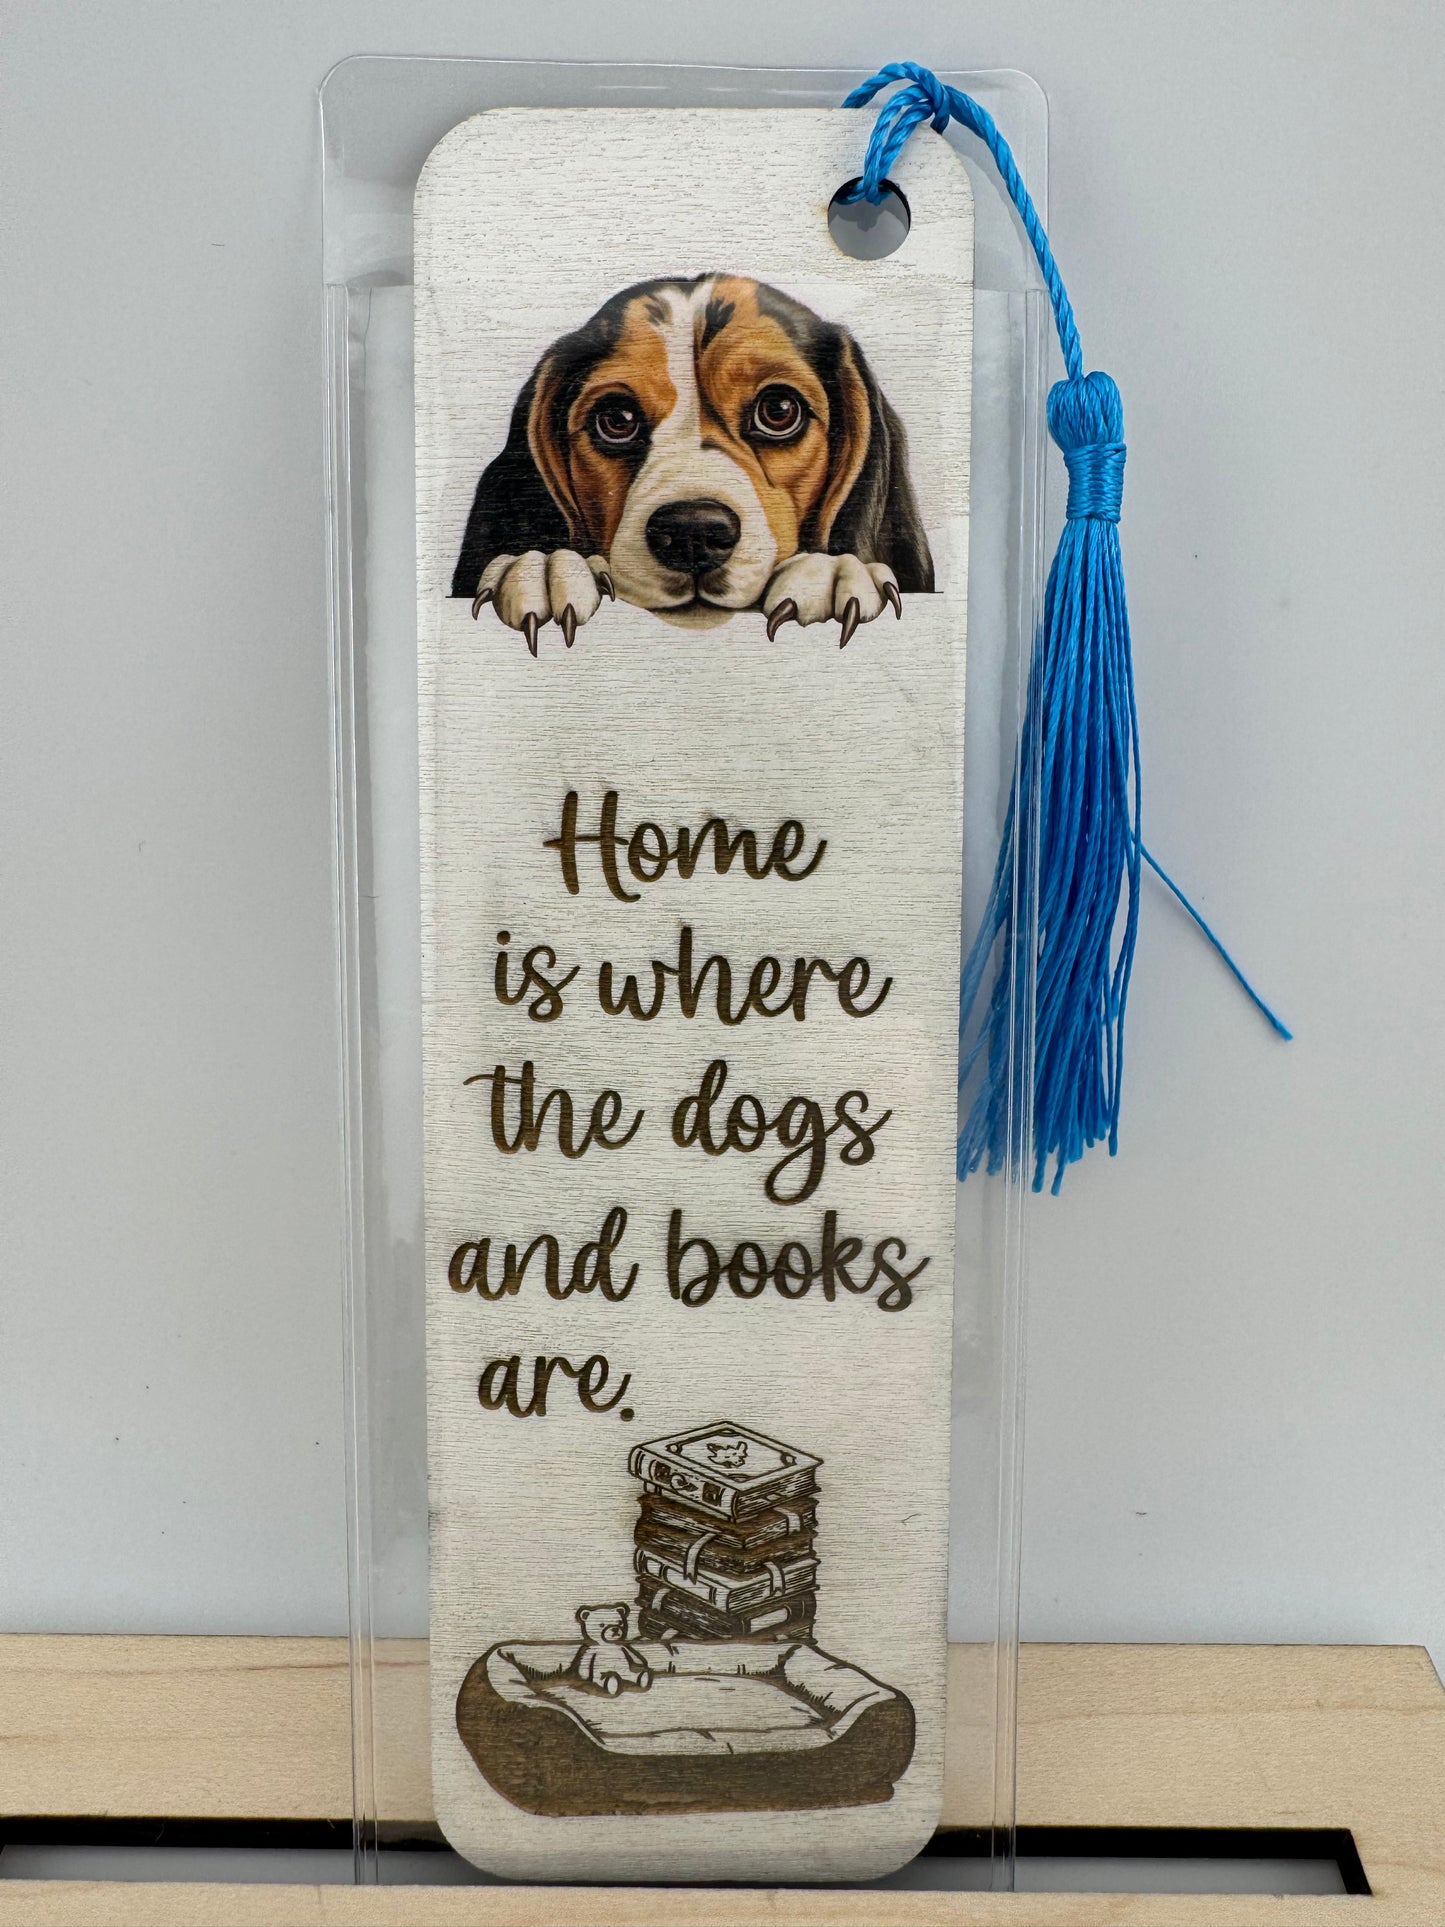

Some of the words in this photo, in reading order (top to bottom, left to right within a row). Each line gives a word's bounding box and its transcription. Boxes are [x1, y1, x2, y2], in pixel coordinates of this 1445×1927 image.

[544, 790, 828, 903] Home
[493, 930, 580, 1022] is
[597, 925, 893, 1026] where
[463, 1060, 645, 1159] the
[671, 1059, 892, 1206] dogs
[448, 1206, 640, 1302] and
[666, 1208, 931, 1312] books
[477, 1355, 635, 1422] are.
